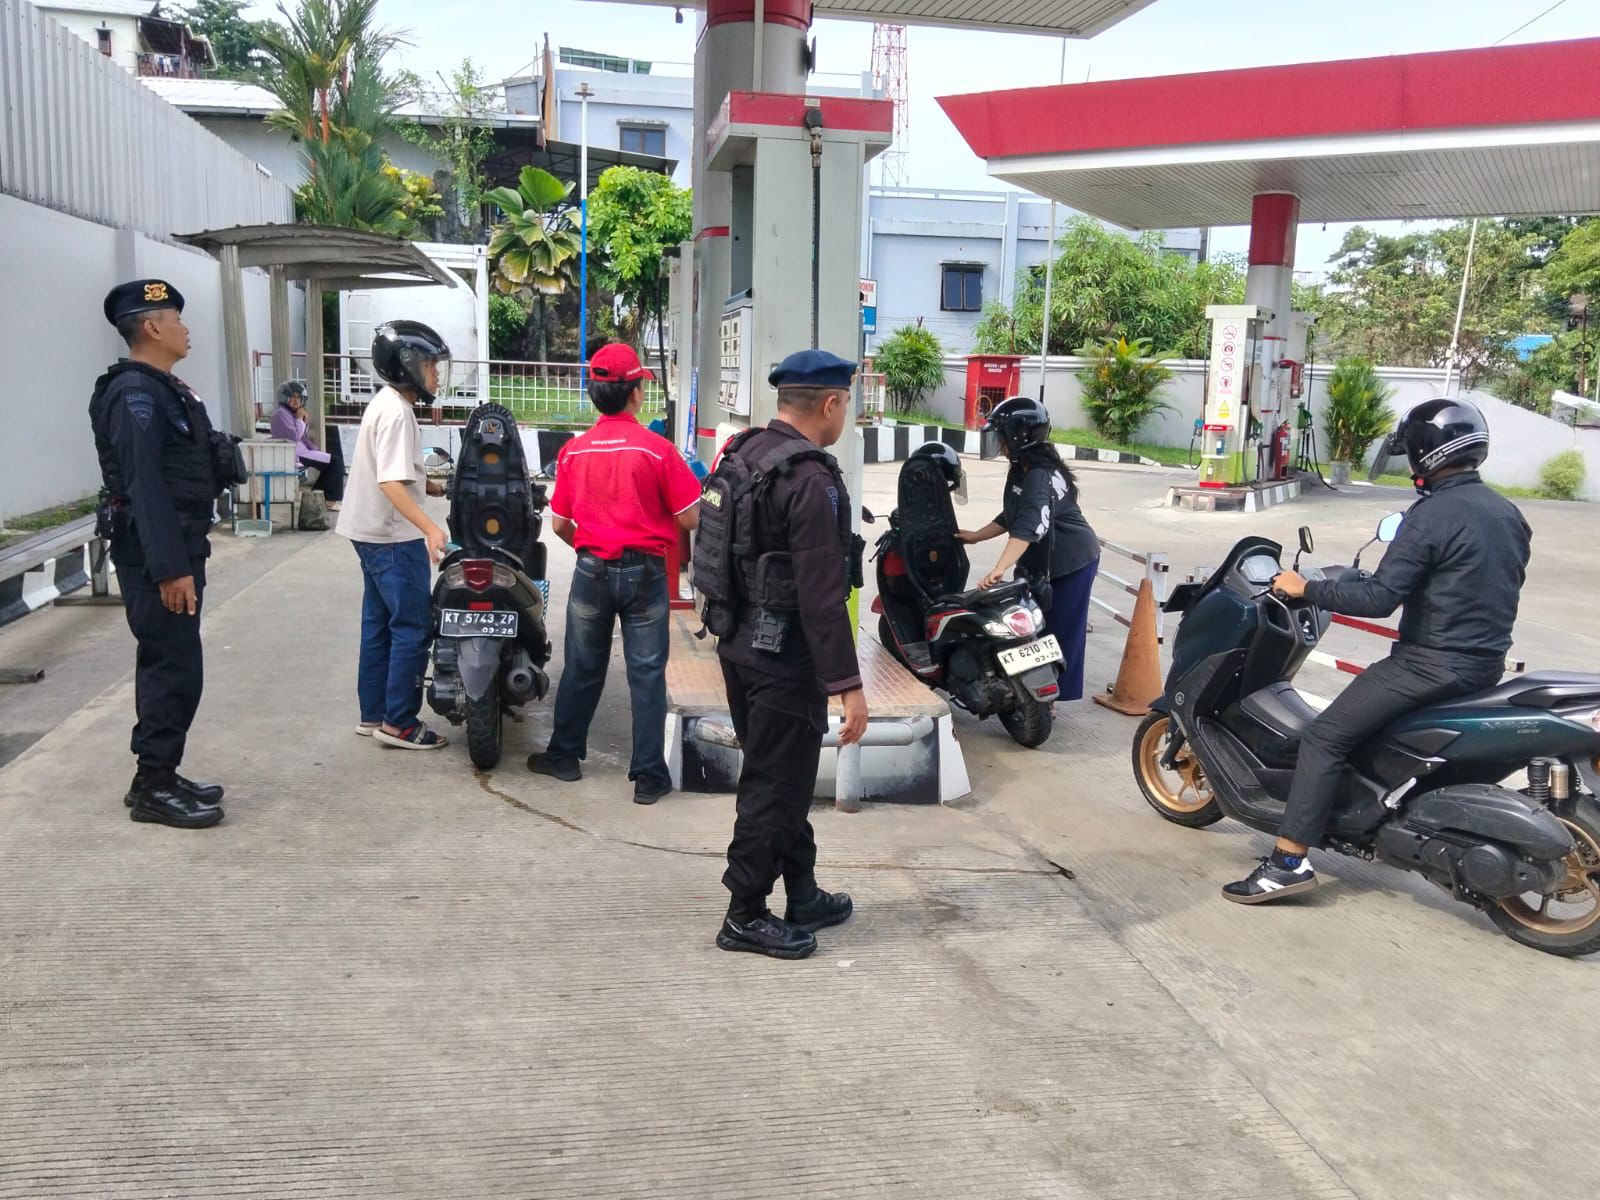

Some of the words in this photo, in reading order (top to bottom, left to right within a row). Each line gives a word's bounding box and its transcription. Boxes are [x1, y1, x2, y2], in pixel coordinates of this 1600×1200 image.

[445, 612, 460, 623] KT
[465, 613, 495, 624] 5743
[500, 614, 515, 624] ZP
[1001, 652, 1015, 664] KT
[1018, 644, 1041, 658] 6210
[1042, 639, 1054, 650] YF
